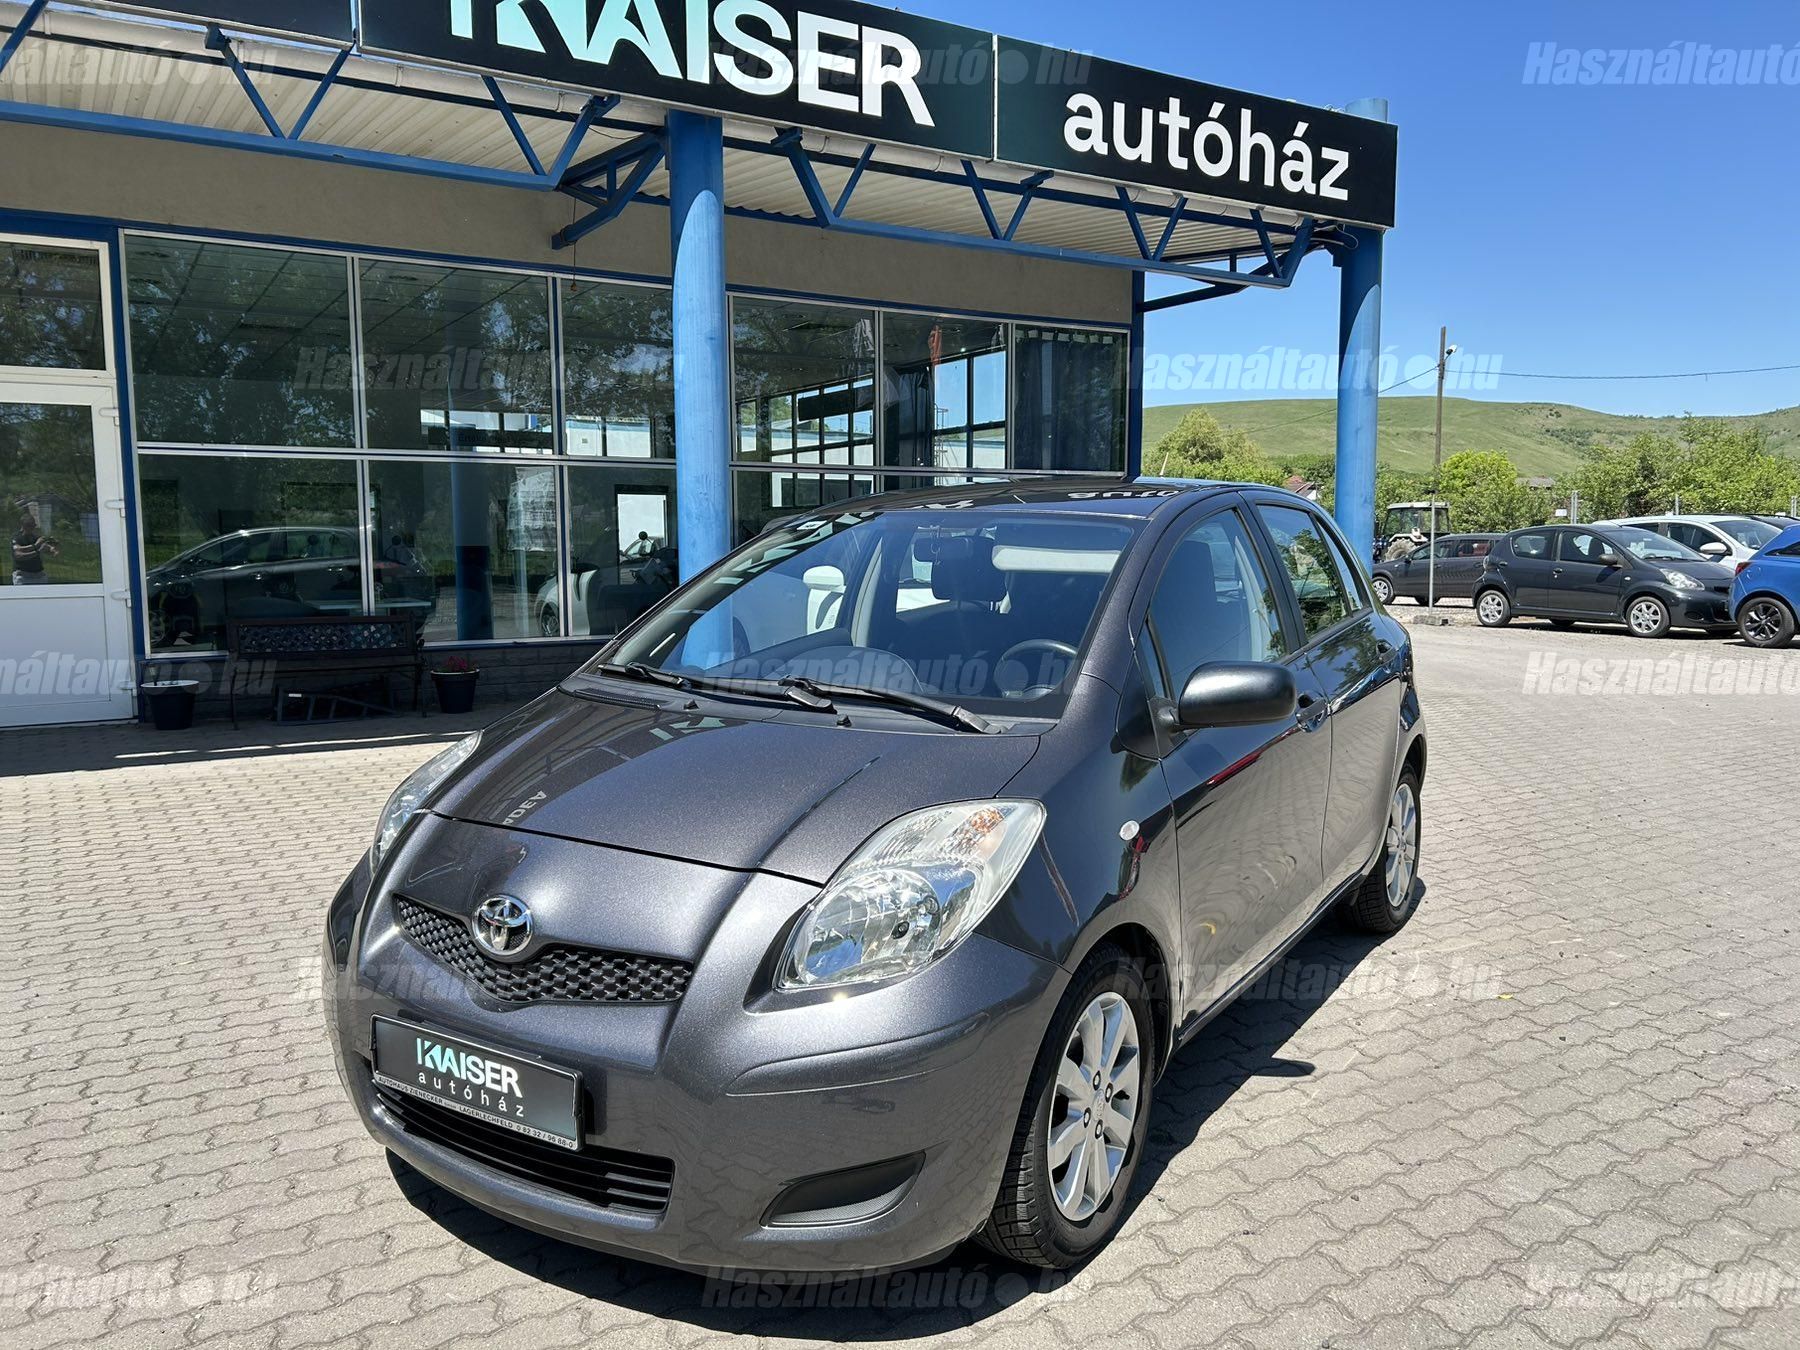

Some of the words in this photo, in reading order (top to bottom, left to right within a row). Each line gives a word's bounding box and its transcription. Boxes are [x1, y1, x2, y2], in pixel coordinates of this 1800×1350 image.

[1063, 92, 1350, 201] autóház
[378, 1076, 408, 1092] AUTOHAUS
[409, 1087, 442, 1104] ZIENECKER
[416, 1037, 523, 1099] KAISER
[418, 1070, 524, 1118] autóház
[460, 1105, 513, 1128] LAGERLECHFELD
